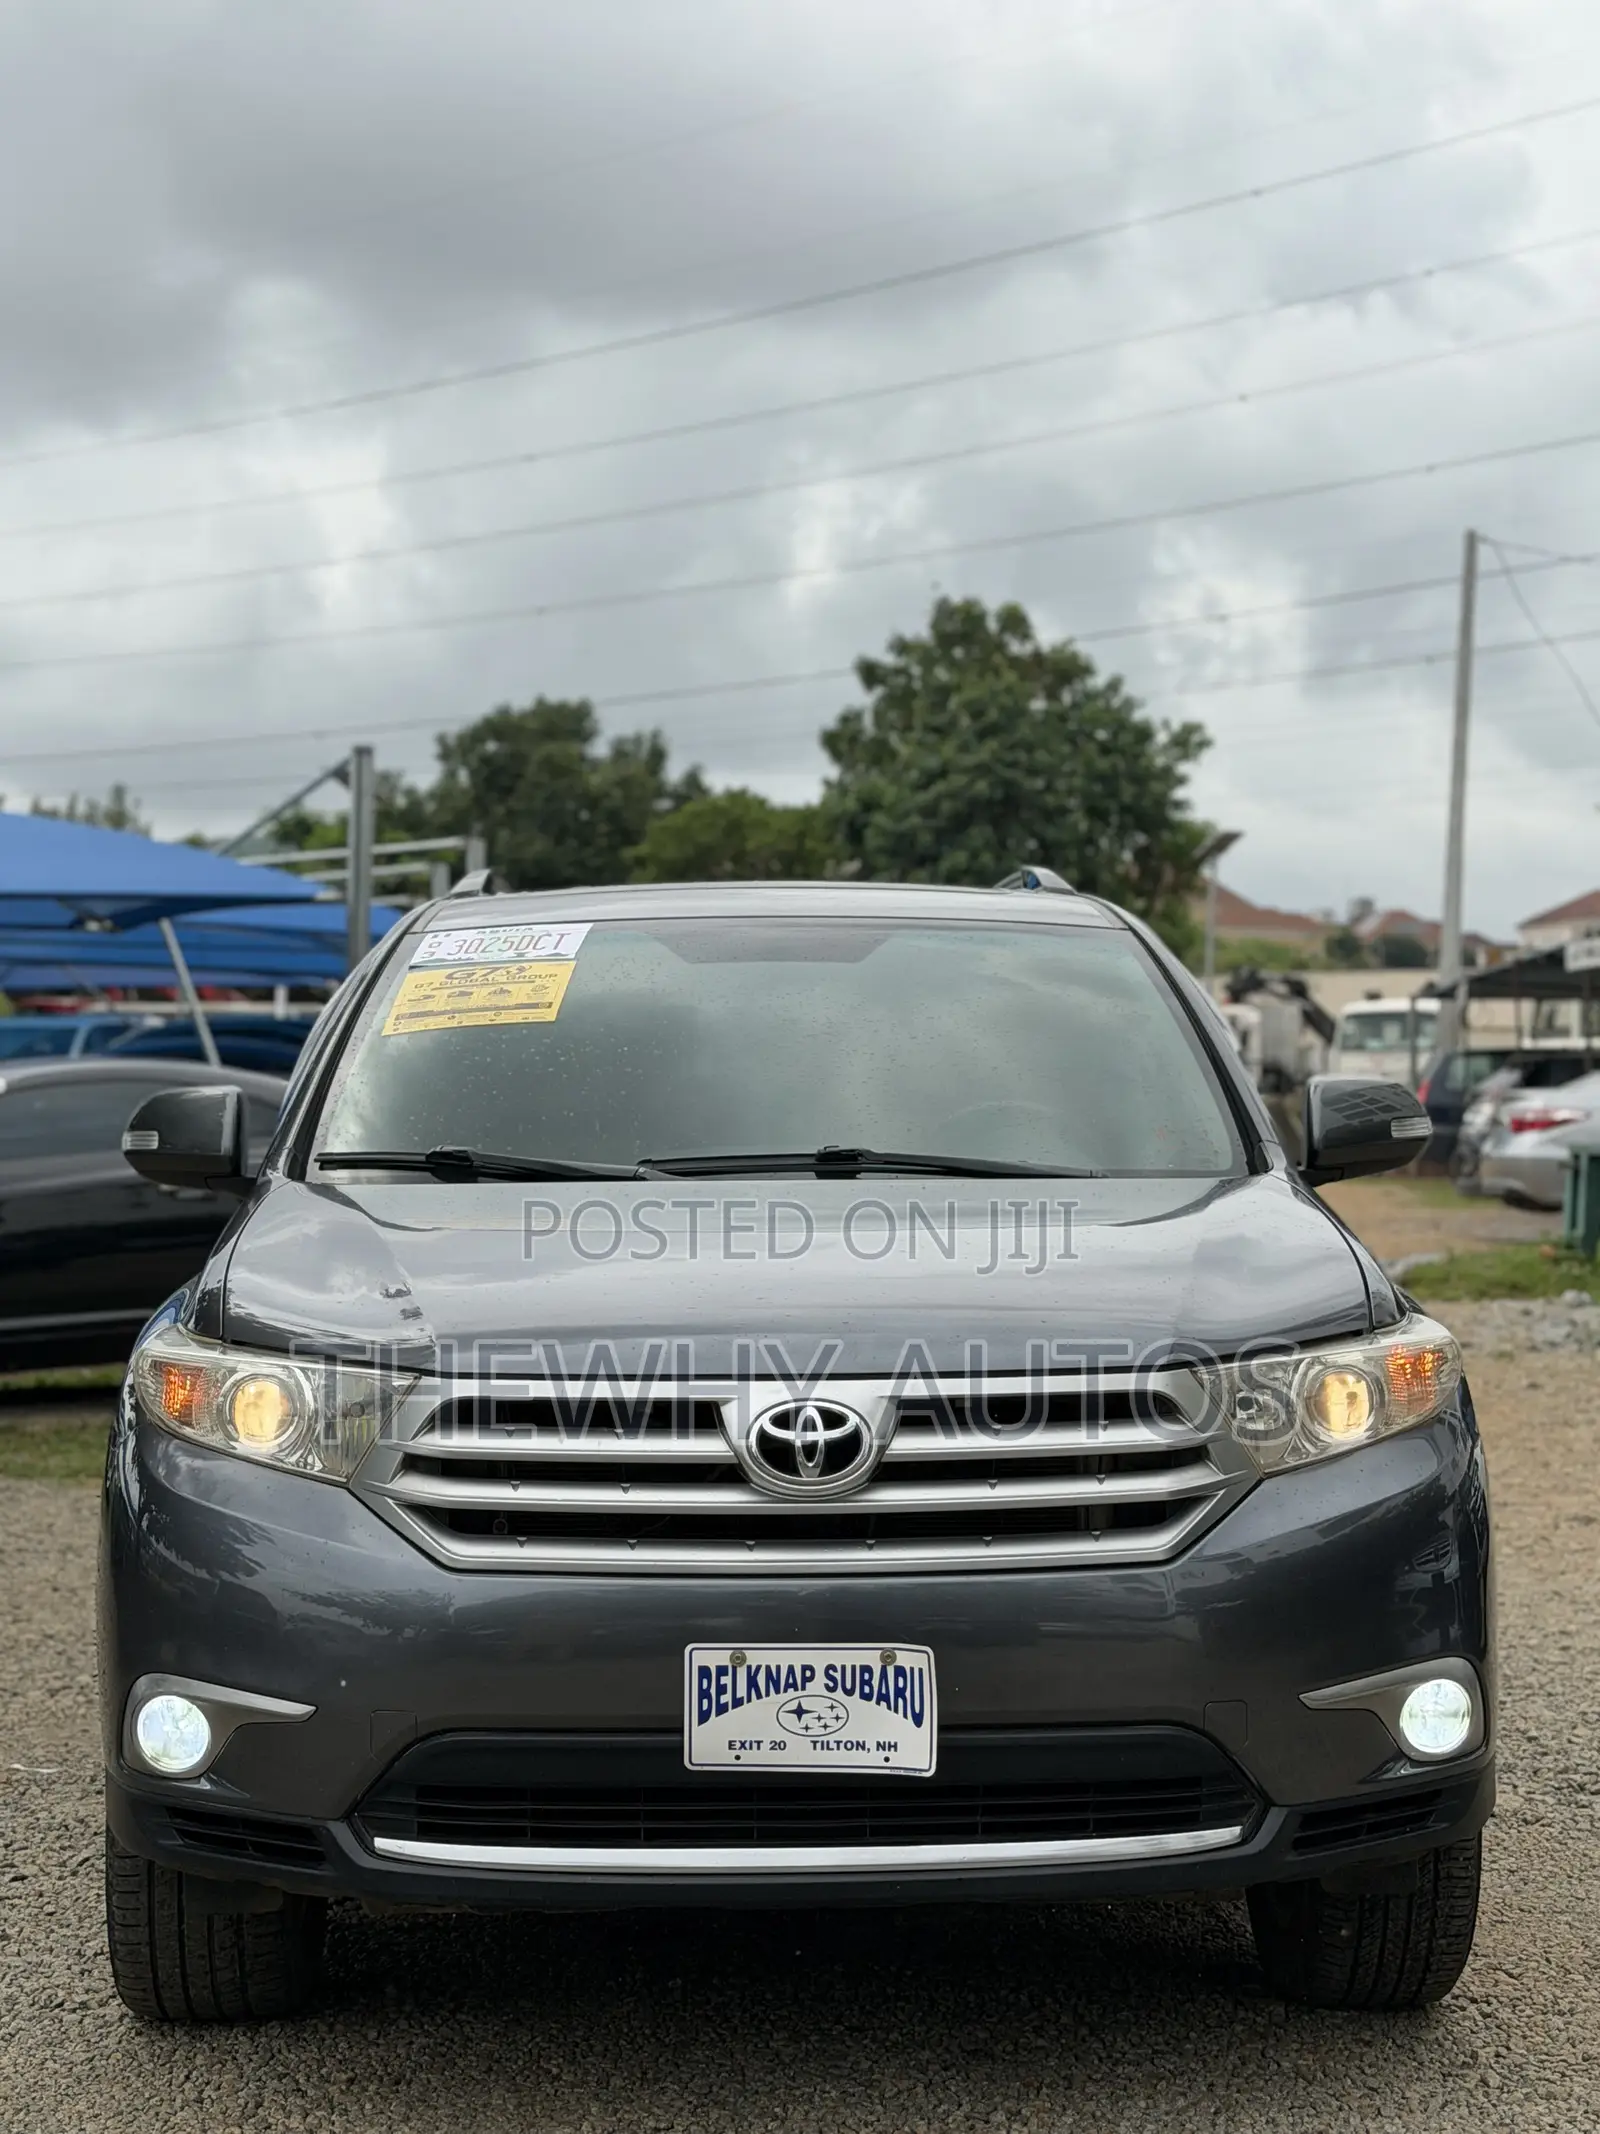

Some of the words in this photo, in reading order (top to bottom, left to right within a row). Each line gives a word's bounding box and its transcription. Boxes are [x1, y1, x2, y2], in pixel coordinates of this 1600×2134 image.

[439, 977, 499, 987] GLOBAL
[507, 973, 559, 982] GROUP
[697, 1663, 816, 1727] BELKNAP
[823, 1663, 925, 1729] SUBARU
[728, 1739, 764, 1751] EXIT
[769, 1739, 787, 1751] 20
[810, 1739, 871, 1754] TILTON,
[875, 1740, 898, 1752] NH
